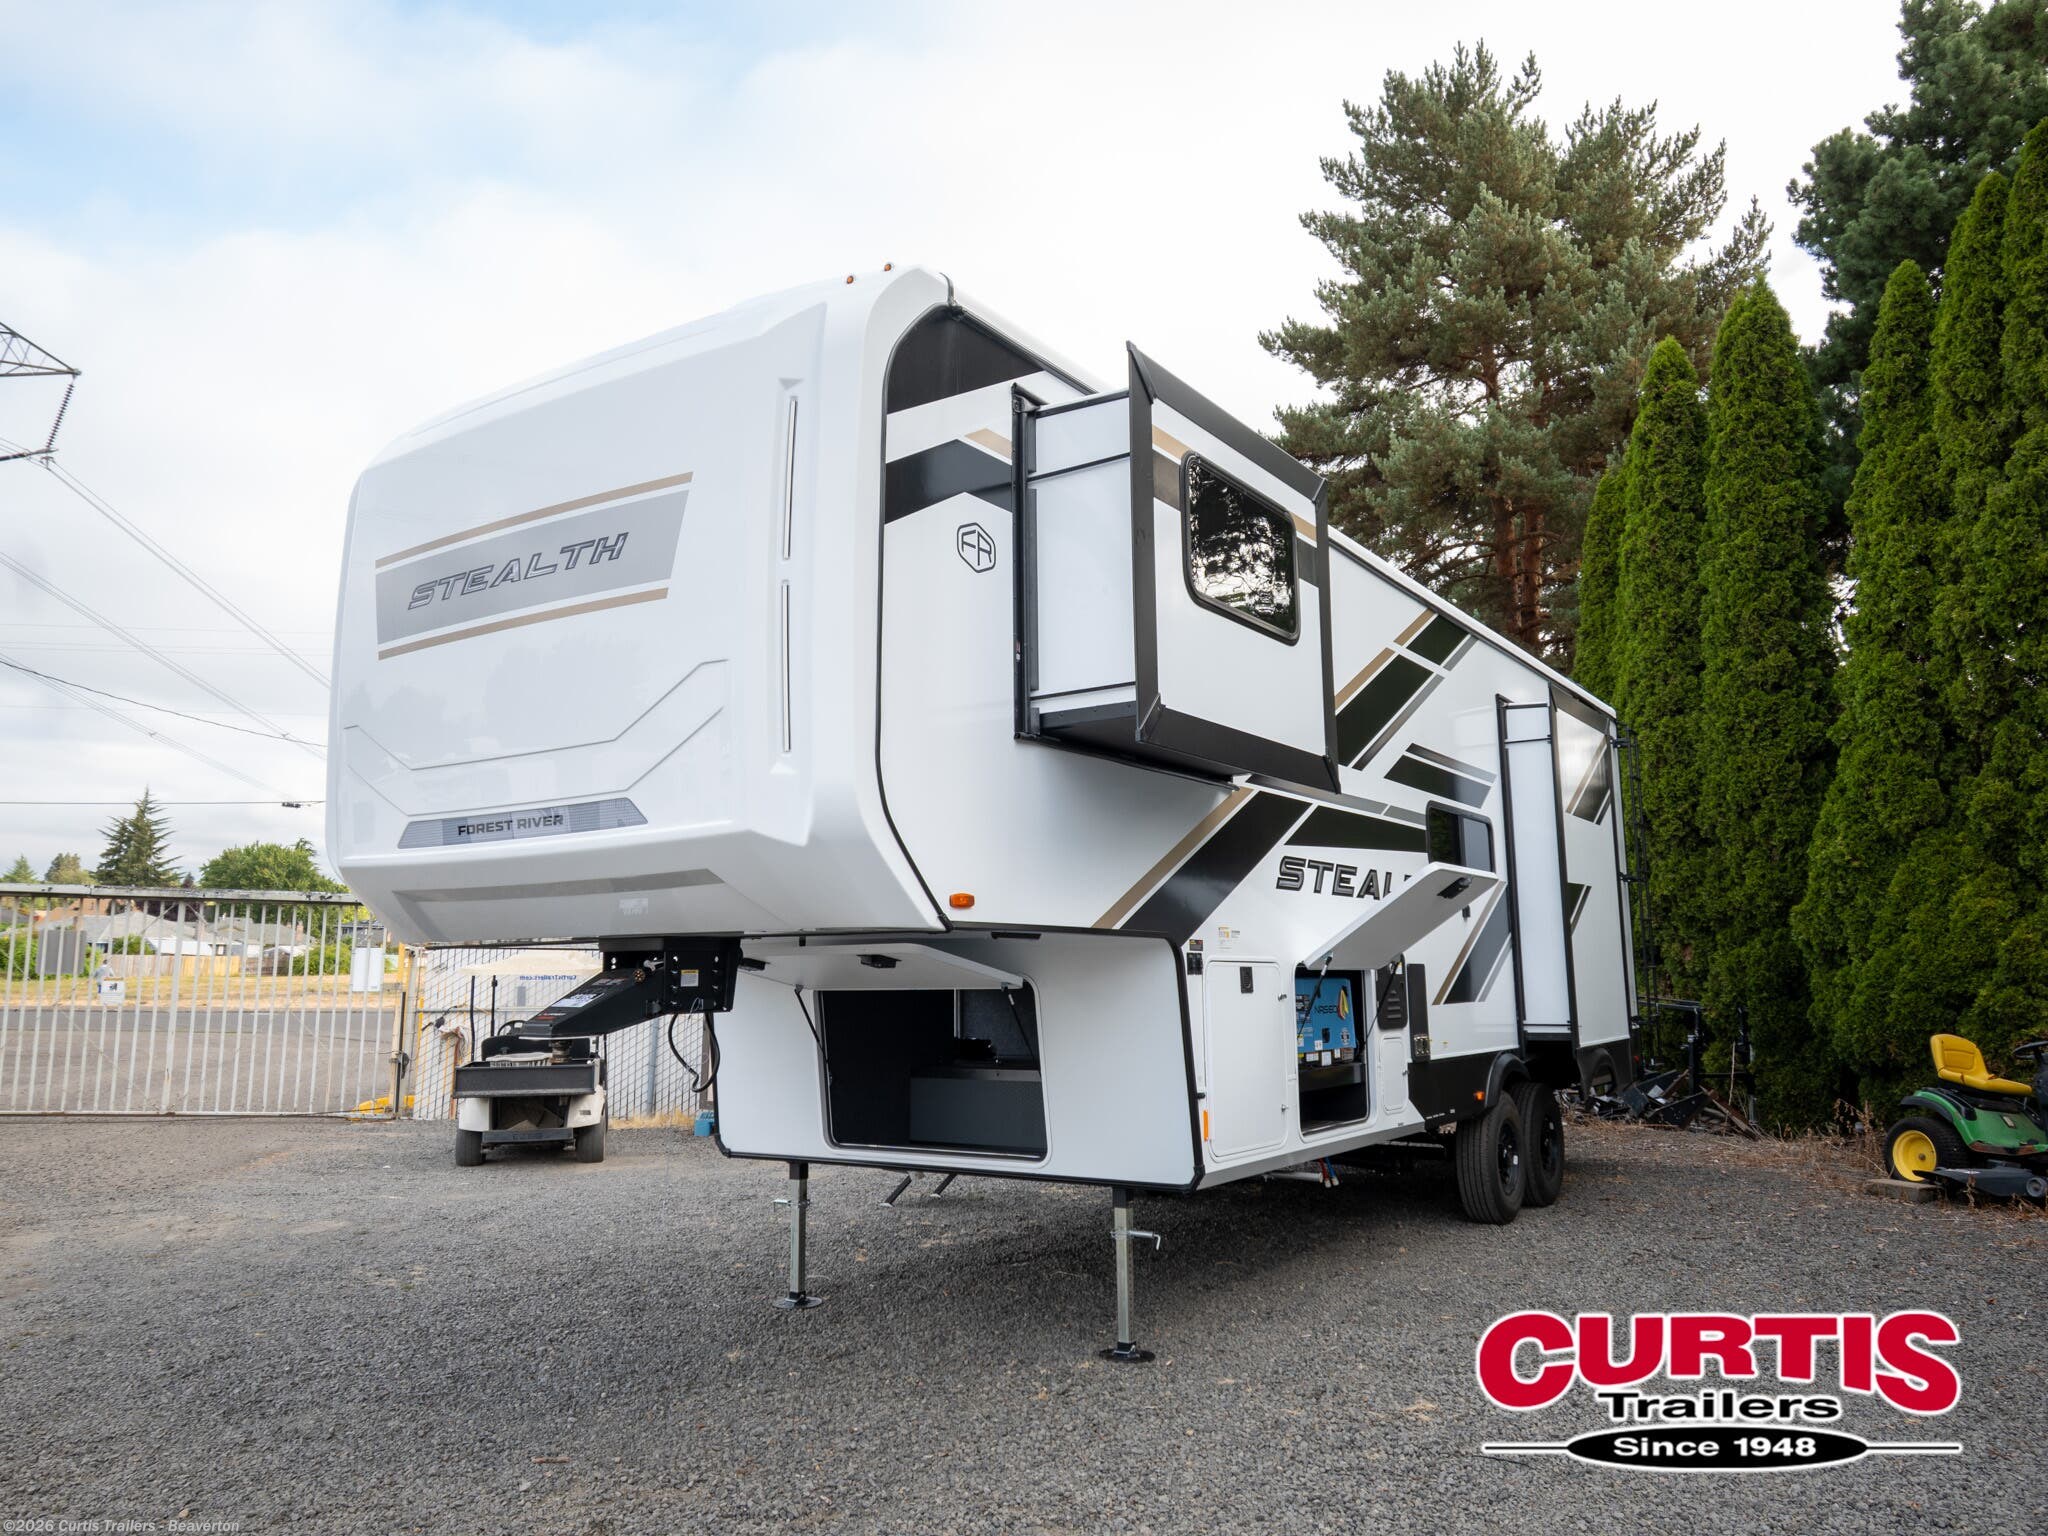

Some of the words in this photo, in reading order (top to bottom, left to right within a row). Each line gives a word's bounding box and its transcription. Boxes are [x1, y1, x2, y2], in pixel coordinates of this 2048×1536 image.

[408, 532, 629, 611] STEALTH
[457, 820, 513, 836] FOREST
[516, 814, 564, 830] RIVER
[1276, 855, 1411, 900] STEAL
